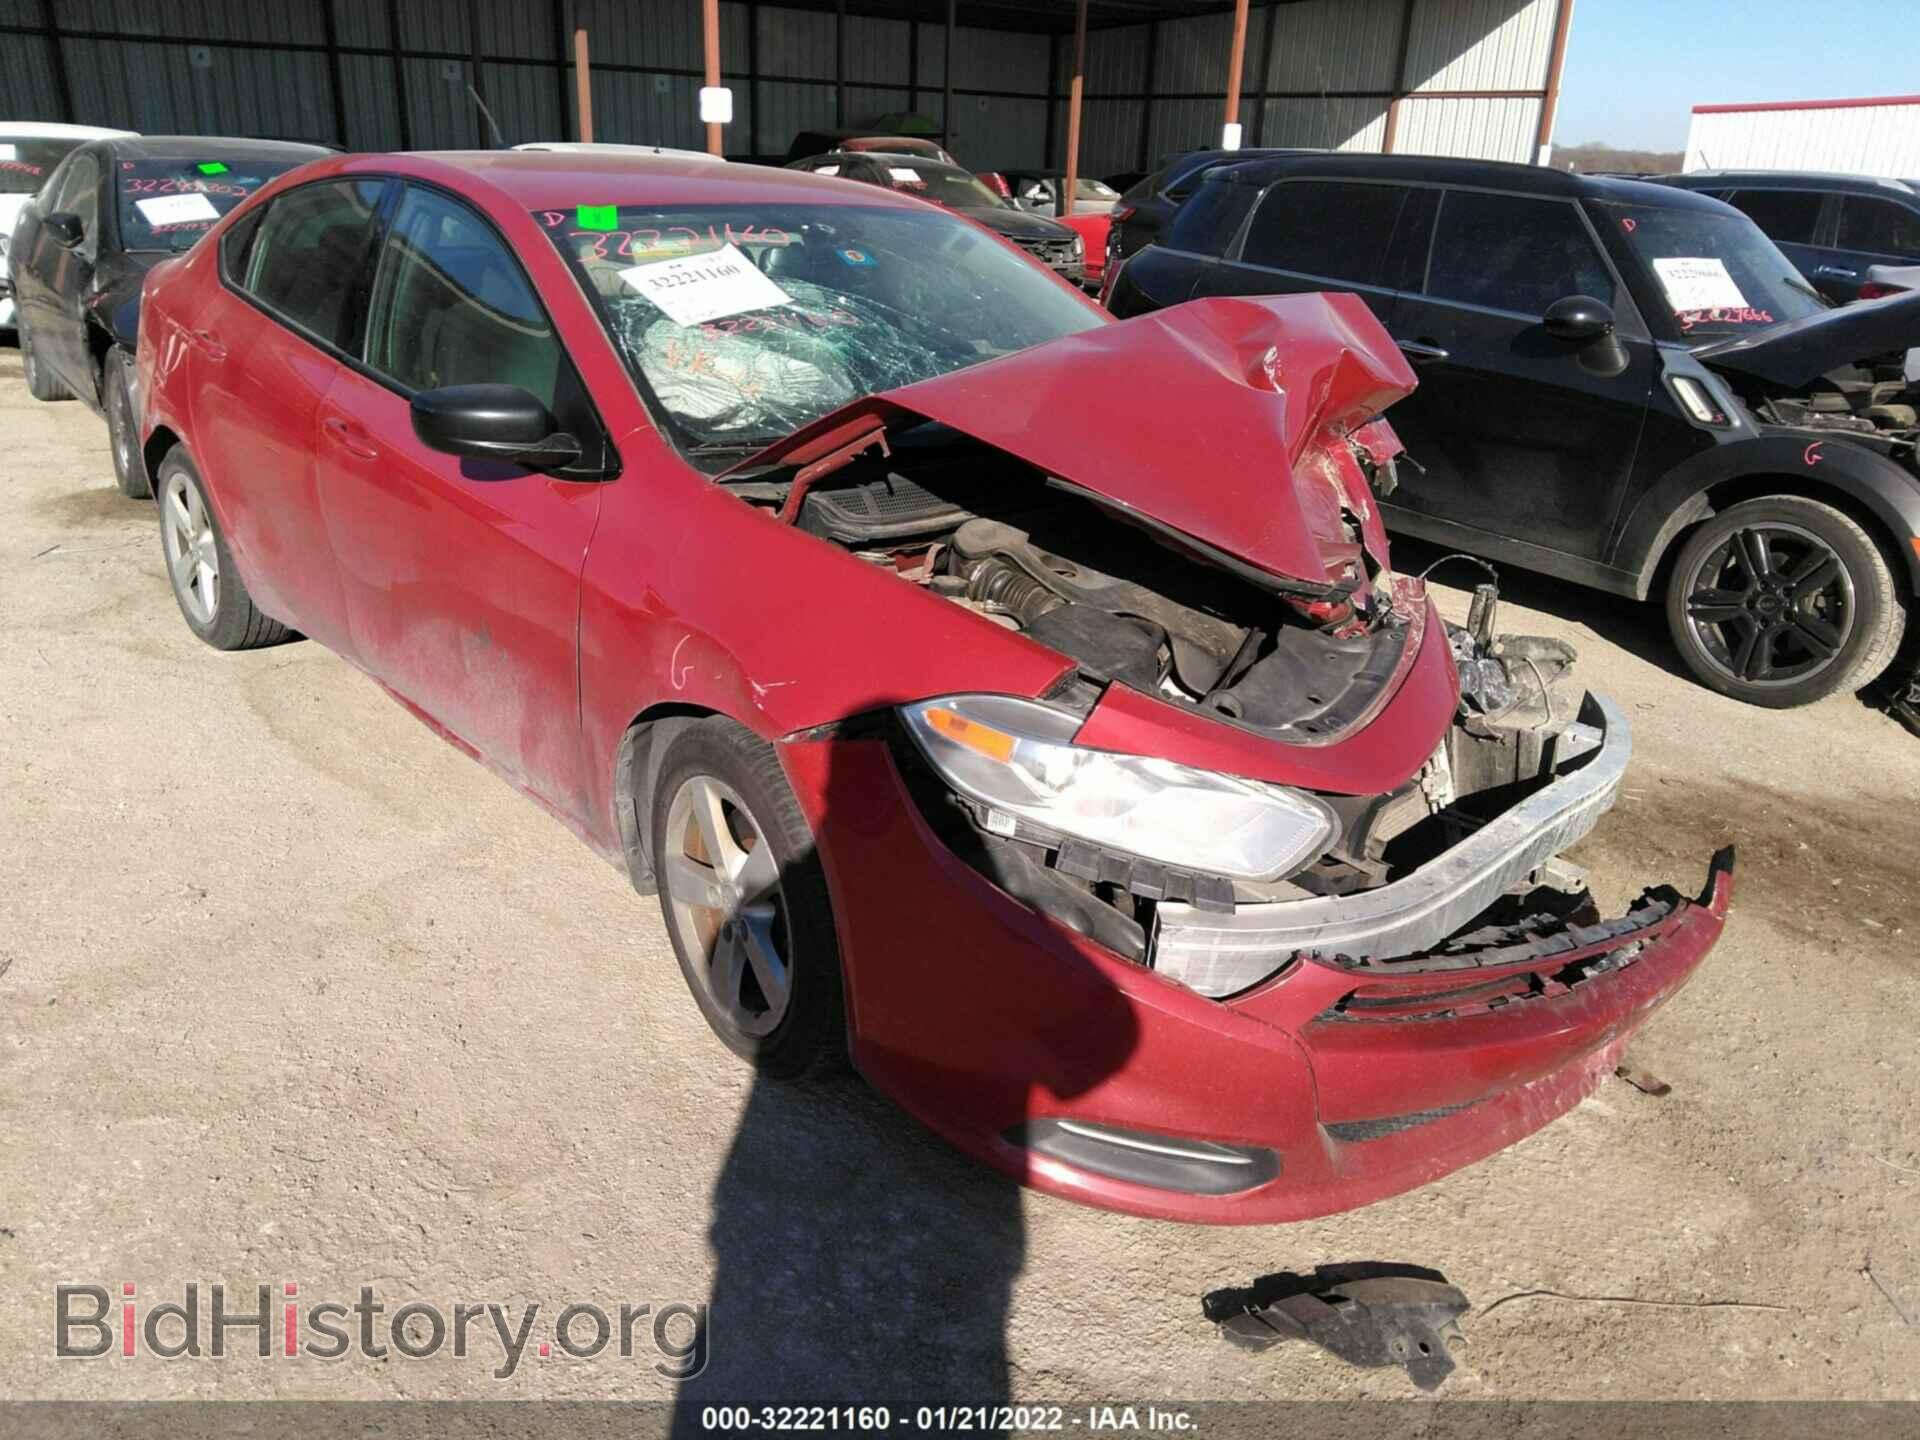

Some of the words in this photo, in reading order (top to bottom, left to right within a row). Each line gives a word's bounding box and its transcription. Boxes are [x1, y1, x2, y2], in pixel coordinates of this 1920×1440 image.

[543, 211, 565, 227] D
[1621, 218, 1637, 232] D
[568, 222, 790, 263] 32221160
[648, 263, 742, 291] 32221160
